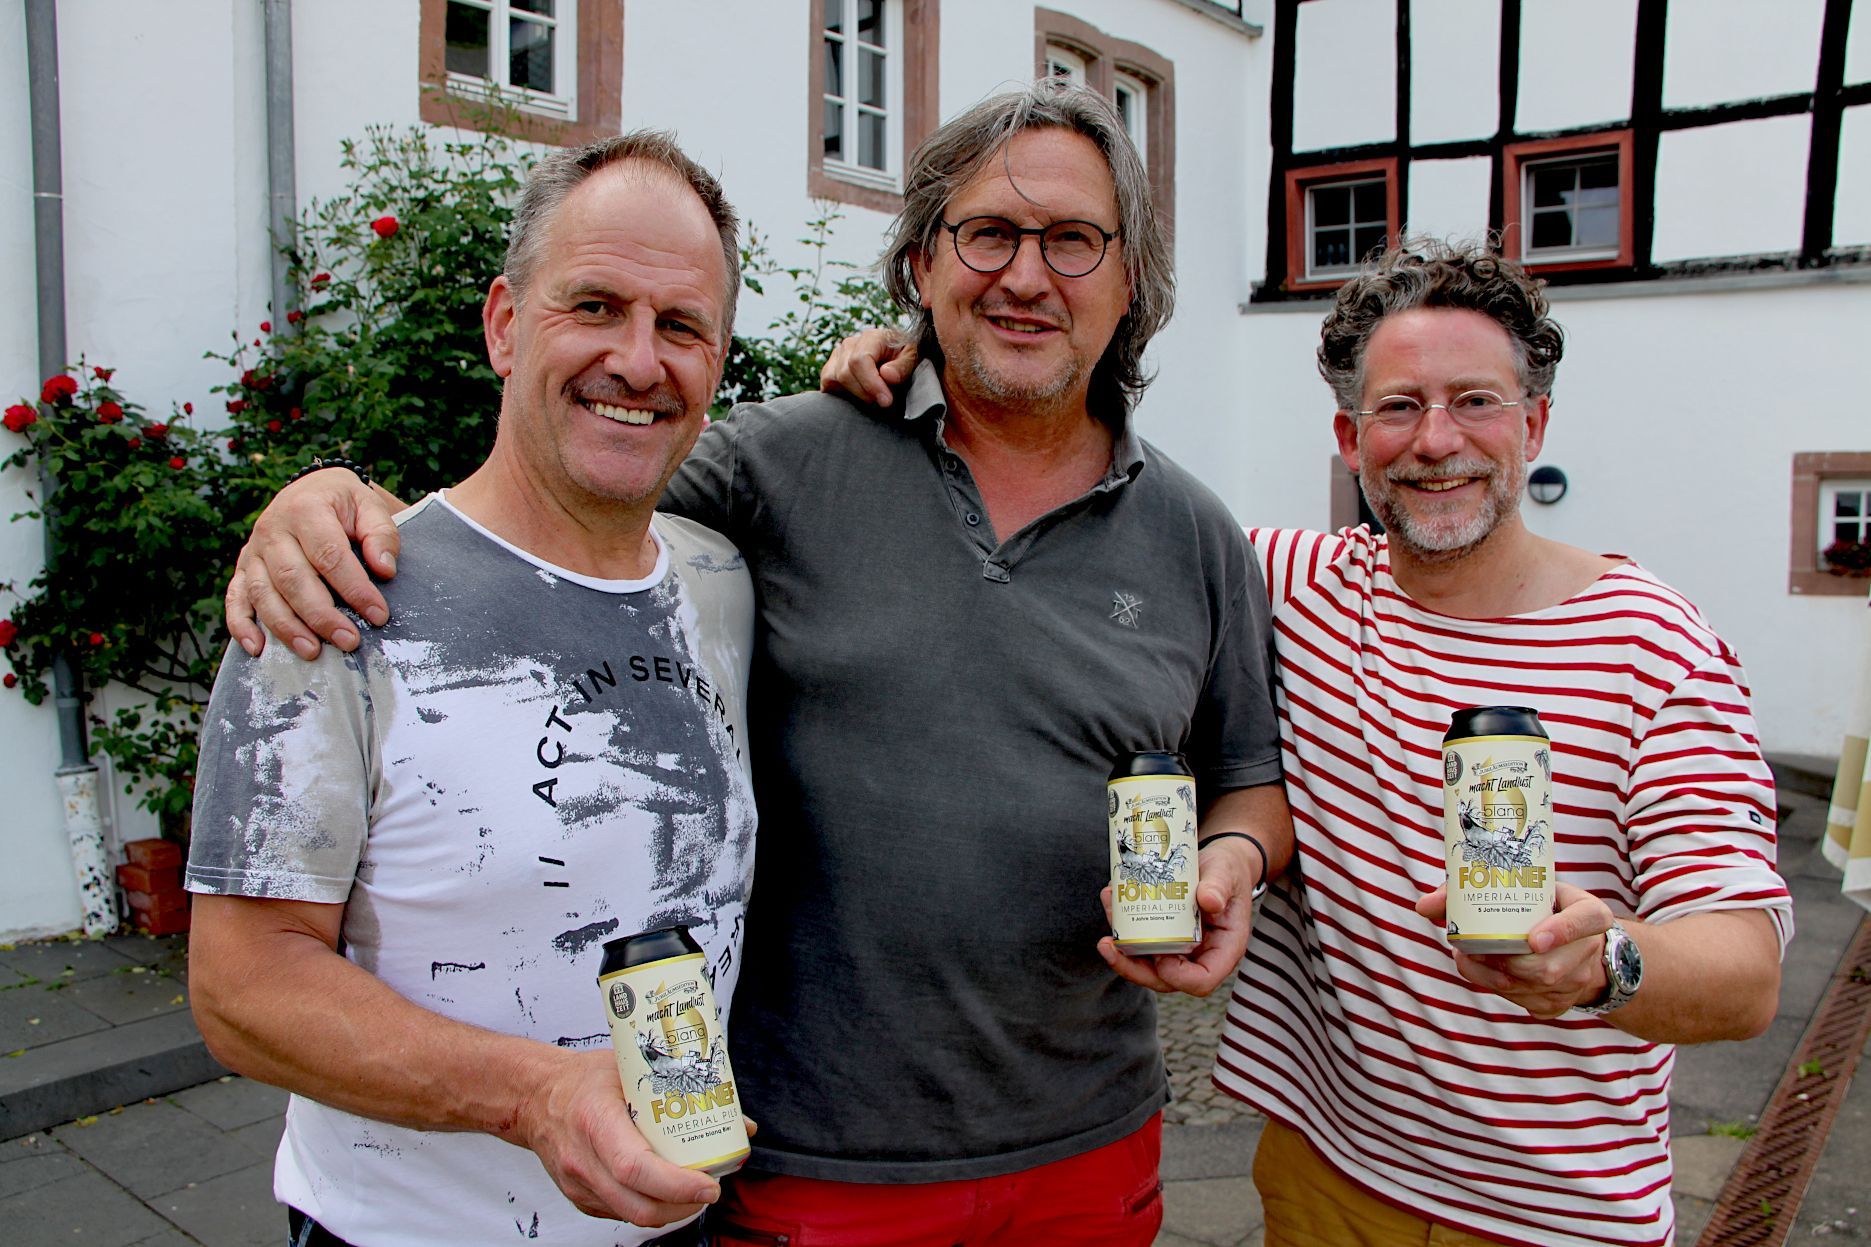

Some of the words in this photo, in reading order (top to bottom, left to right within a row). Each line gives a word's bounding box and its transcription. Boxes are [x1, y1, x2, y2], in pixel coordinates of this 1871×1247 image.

[532, 705, 572, 808] ACT
[572, 661, 617, 703] IN
[1469, 778, 1498, 794] macht
[1497, 776, 1534, 792] Landlust
[1124, 810, 1146, 824] macht
[1146, 807, 1177, 822] Landlust
[1463, 892, 1519, 902] IMPERIAL
[1524, 892, 1544, 902] PILS
[1122, 904, 1164, 912] IMPERIAL
[646, 1002, 675, 1022] macht
[676, 992, 706, 1016] Landlust
[662, 1114, 718, 1135] IMPERIAL
[722, 1108, 738, 1120] PILS
[686, 1133, 704, 1142] Jahre
